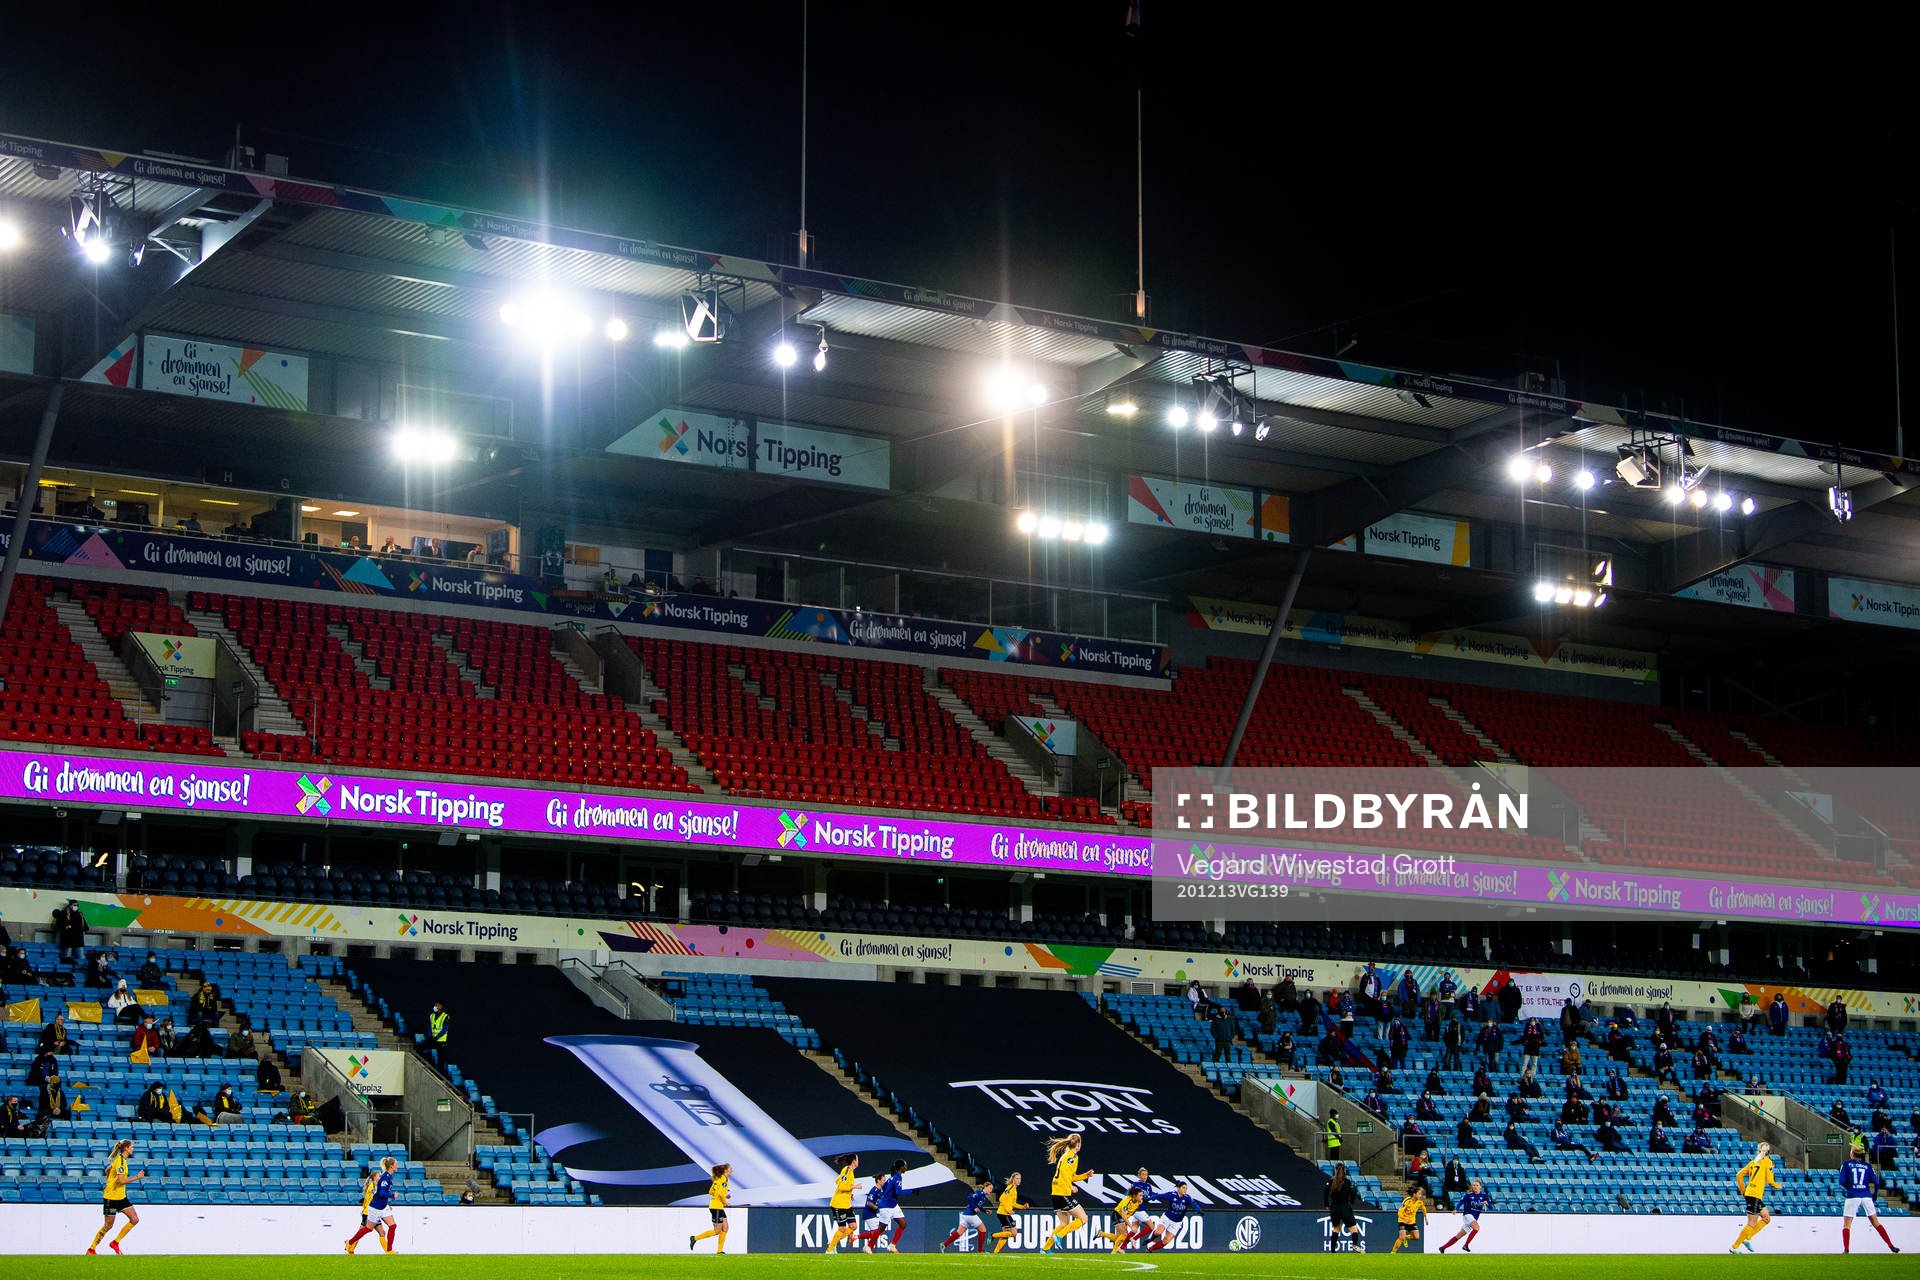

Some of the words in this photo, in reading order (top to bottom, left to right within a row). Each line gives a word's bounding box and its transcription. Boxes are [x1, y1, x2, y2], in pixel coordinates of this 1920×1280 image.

[185, 343, 197, 358] Gi
[161, 349, 221, 377] drømmen
[173, 376, 186, 387] en
[189, 375, 231, 396] sjanse!
[697, 429, 760, 461] Norsk
[763, 439, 842, 477] Tipping
[1184, 493, 1226, 517] drømmen
[1200, 487, 1209, 501] Gi
[1193, 515, 1203, 525] en
[1205, 513, 1234, 533] sjanse!
[1369, 527, 1400, 543] Norsk
[1401, 530, 1440, 551] Tipping
[144, 541, 160, 564] Gi
[164, 542, 222, 569] drømmen
[225, 554, 242, 569] en
[244, 556, 292, 577] sjanse!
[432, 577, 473, 596] Norsk
[474, 581, 523, 603] Tipping
[664, 604, 701, 621] Norsk
[702, 607, 749, 628] Tipping
[1866, 598, 1893, 614] Norsk
[1894, 602, 1920, 618] Tippin
[1226, 610, 1256, 625] Norsk
[1258, 613, 1294, 632] Tipg
[849, 619, 865, 639] Gi
[866, 620, 912, 641] drømmen
[913, 631, 927, 644] en
[929, 630, 967, 650] sjanse!
[1079, 647, 1111, 665] Norsk
[1112, 650, 1152, 671] Tipping
[1496, 642, 1529, 660] Tipping
[23, 760, 48, 794] Gi
[55, 761, 144, 795] drømmen
[149, 773, 174, 797] en
[179, 773, 250, 806] sjanse!
[340, 784, 412, 816] Norsk
[415, 788, 505, 827] Tipping
[546, 798, 568, 828] Gi
[574, 798, 648, 830] drømmen
[653, 810, 674, 831] en
[679, 810, 739, 840] sjanse!
[814, 820, 876, 848] Norsk
[878, 824, 955, 860] Tipping
[990, 832, 1009, 860] Gi
[1014, 833, 1078, 861] drømmen
[1082, 843, 1100, 862] en
[1104, 841, 1155, 871] sjanse!
[1454, 872, 1470, 889] en
[1472, 870, 1518, 896] sjanse!
[1575, 878, 1623, 901] Norsk
[1624, 881, 1682, 911] Tipping
[1709, 886, 1723, 909] Gi
[1726, 886, 1776, 910] drømmen
[1778, 896, 1793, 912] en
[1795, 894, 1835, 918] sjanse!
[423, 918, 464, 936] Norsk
[466, 921, 518, 942] Tipping
[840, 939, 853, 956] Gi
[856, 940, 899, 957] drømmen
[902, 946, 914, 957] en
[917, 943, 952, 962] sjanse!
[1242, 962, 1274, 977] Norsk
[1275, 964, 1314, 982] Tipping
[1588, 981, 1598, 996] Gi
[1635, 988, 1645, 998] en
[1646, 985, 1673, 1001] sjanse!
[949, 1079, 1154, 1114] THON
[1015, 1115, 1182, 1135] HOTELS
[1215, 1174, 1287, 1192] mini
[1851, 1167, 1866, 1185] 17
[1239, 1191, 1302, 1209] pris
[1323, 1240, 1366, 1252] HOTES
